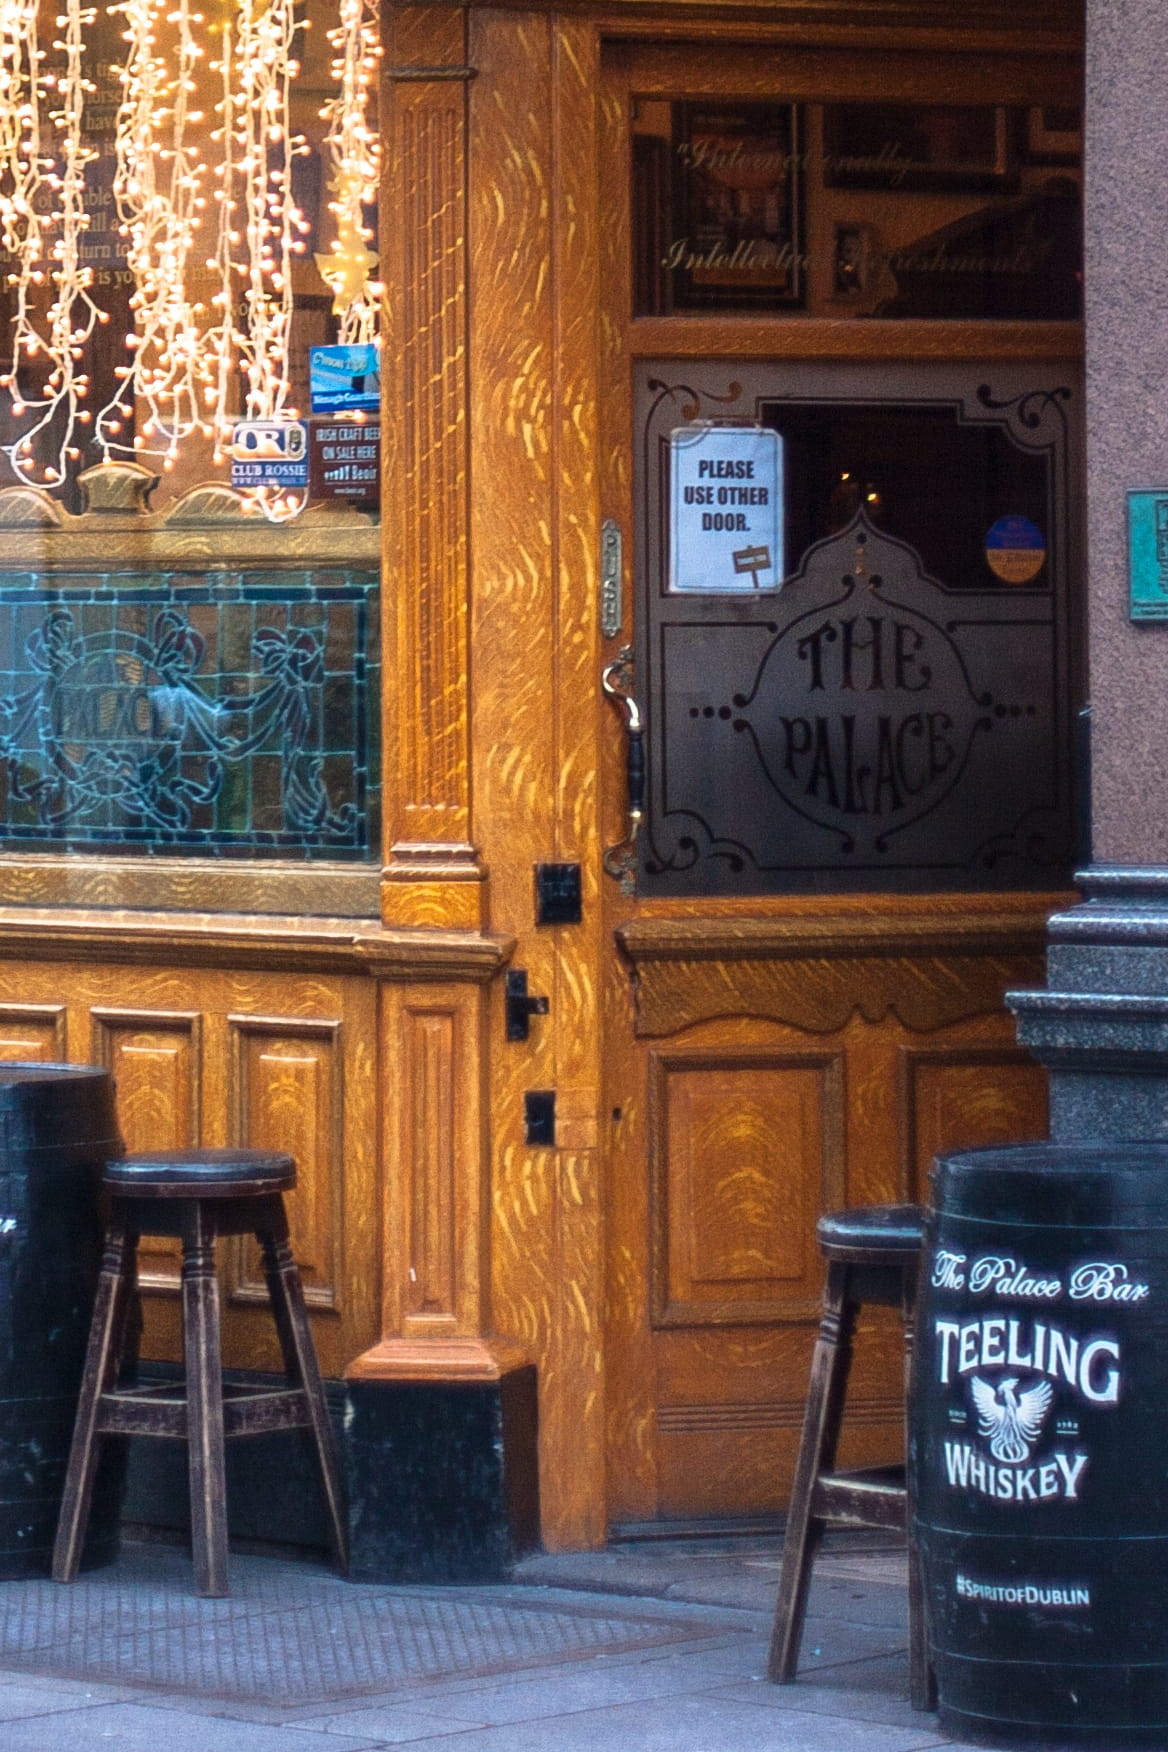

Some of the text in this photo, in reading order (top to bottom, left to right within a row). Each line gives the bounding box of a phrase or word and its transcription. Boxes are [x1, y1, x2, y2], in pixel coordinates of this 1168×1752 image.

[231, 464, 307, 476] CLUB ROSSIE
[684, 486, 769, 506] USE OTHER
[697, 459, 755, 480] PLEASE
[701, 512, 751, 532] DOOR.
[796, 615, 934, 691] THE
[780, 712, 954, 816] PALACE
[932, 1249, 1150, 1303] The Palace Bar
[935, 1318, 1120, 1404] TEELING
[944, 1441, 1088, 1501] WHISKEY
